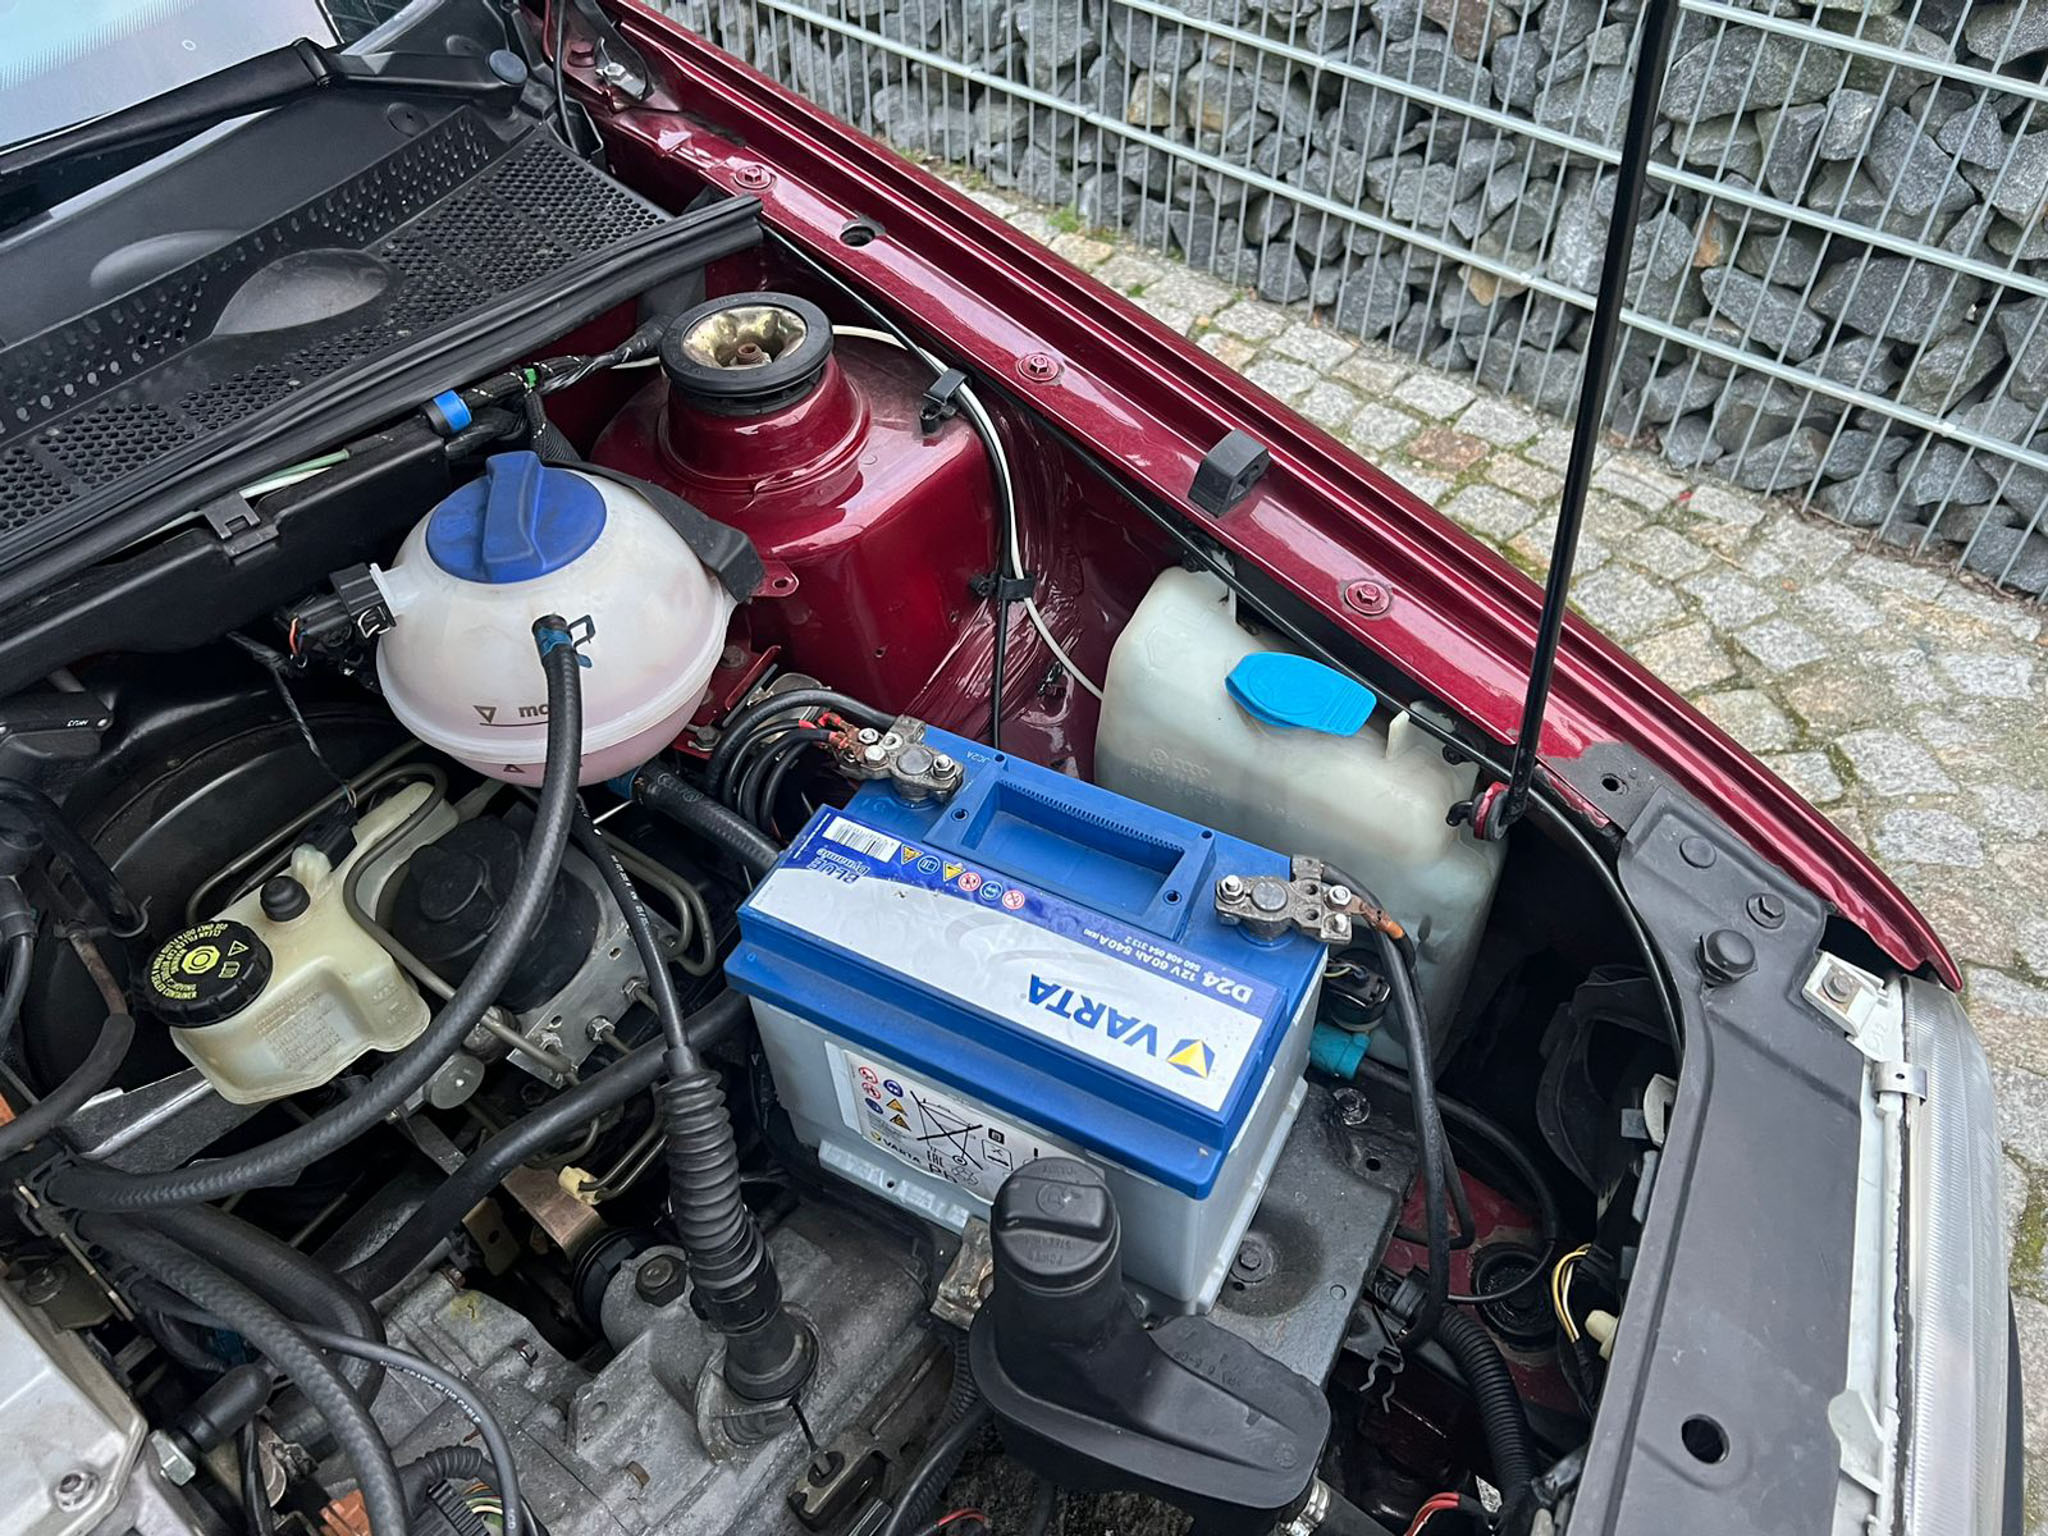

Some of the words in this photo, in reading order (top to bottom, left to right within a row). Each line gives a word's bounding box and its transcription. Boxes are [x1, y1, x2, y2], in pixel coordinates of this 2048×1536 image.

[519, 704, 549, 718] ma
[806, 857, 861, 884] BLUE
[816, 847, 870, 877] Dynamic
[1135, 950, 1169, 970] 60Ah
[1170, 966, 1196, 982] 12V
[1202, 971, 1254, 1004] D24
[1027, 973, 1158, 1057] VARTA
